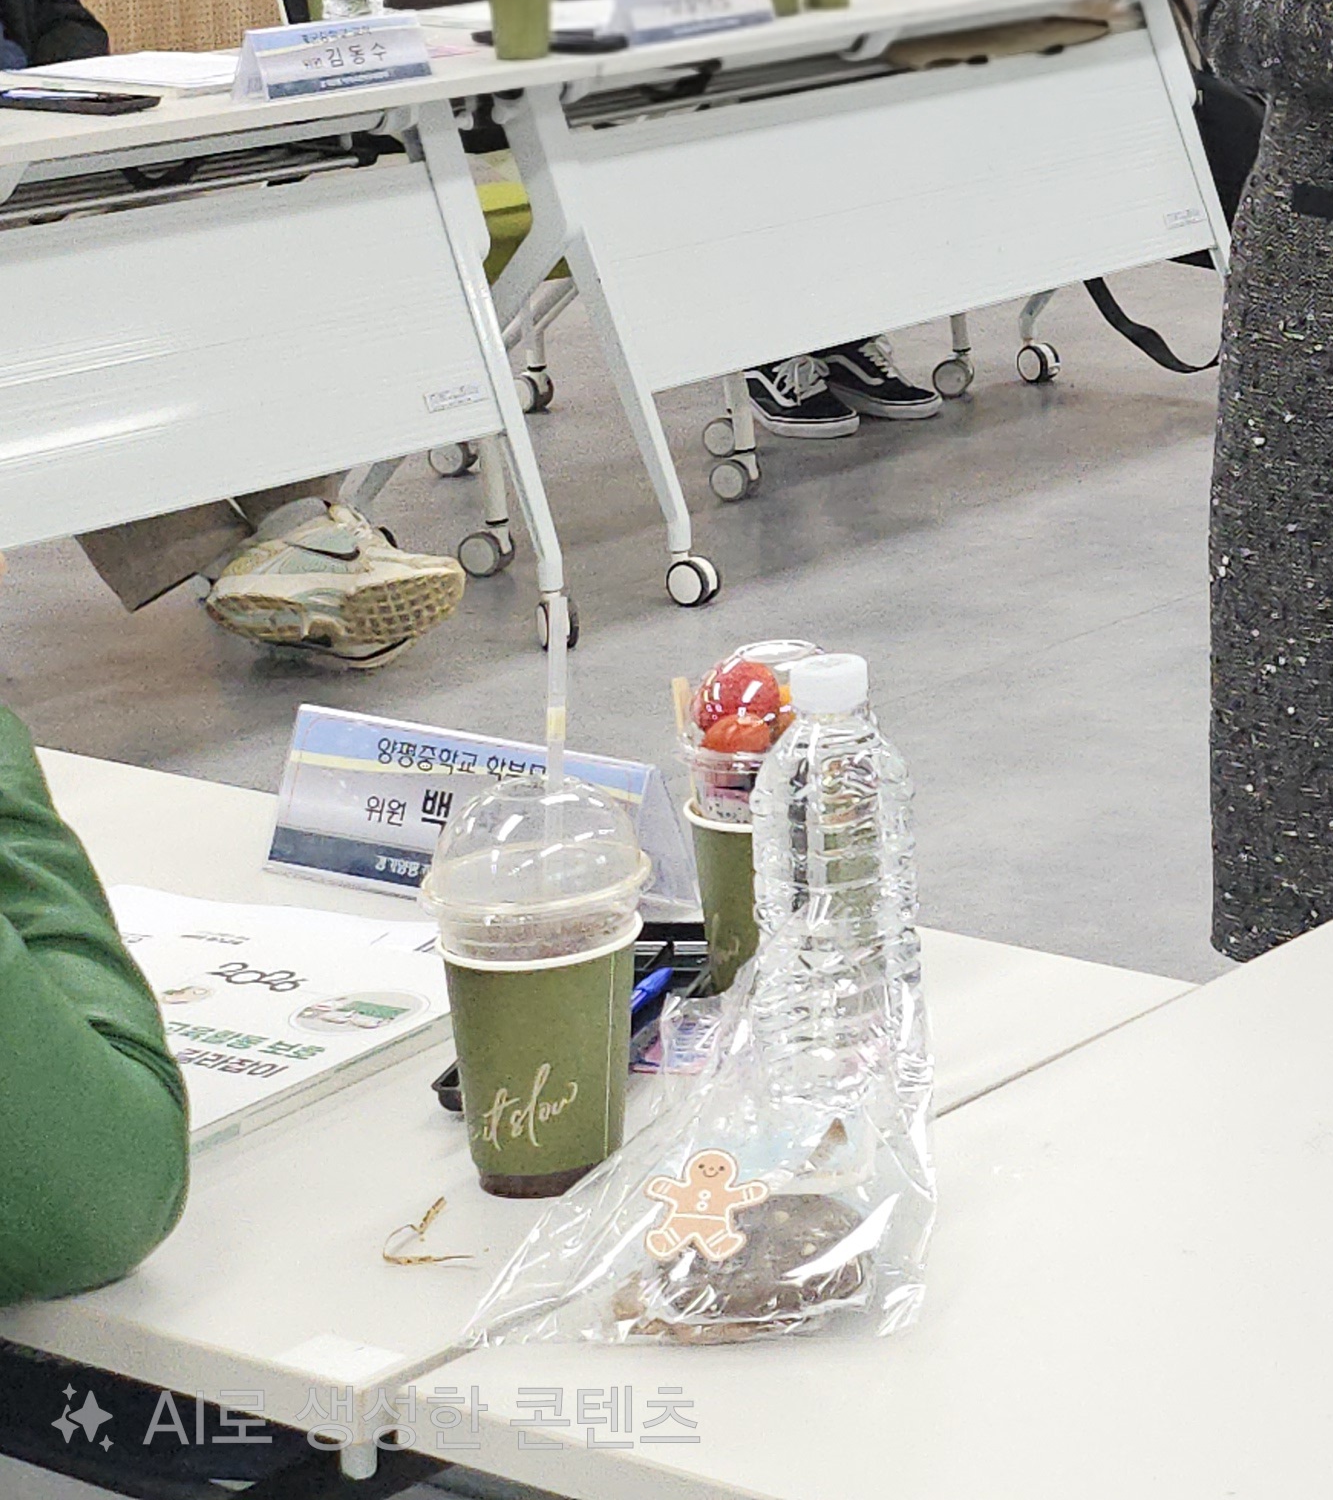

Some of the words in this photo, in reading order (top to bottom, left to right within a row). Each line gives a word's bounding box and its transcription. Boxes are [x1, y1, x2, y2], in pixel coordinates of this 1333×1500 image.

[325, 42, 387, 68] 김동수
[376, 737, 478, 775] 양평중학교
[365, 795, 406, 827] 위원
[206, 962, 308, 992] 2026
